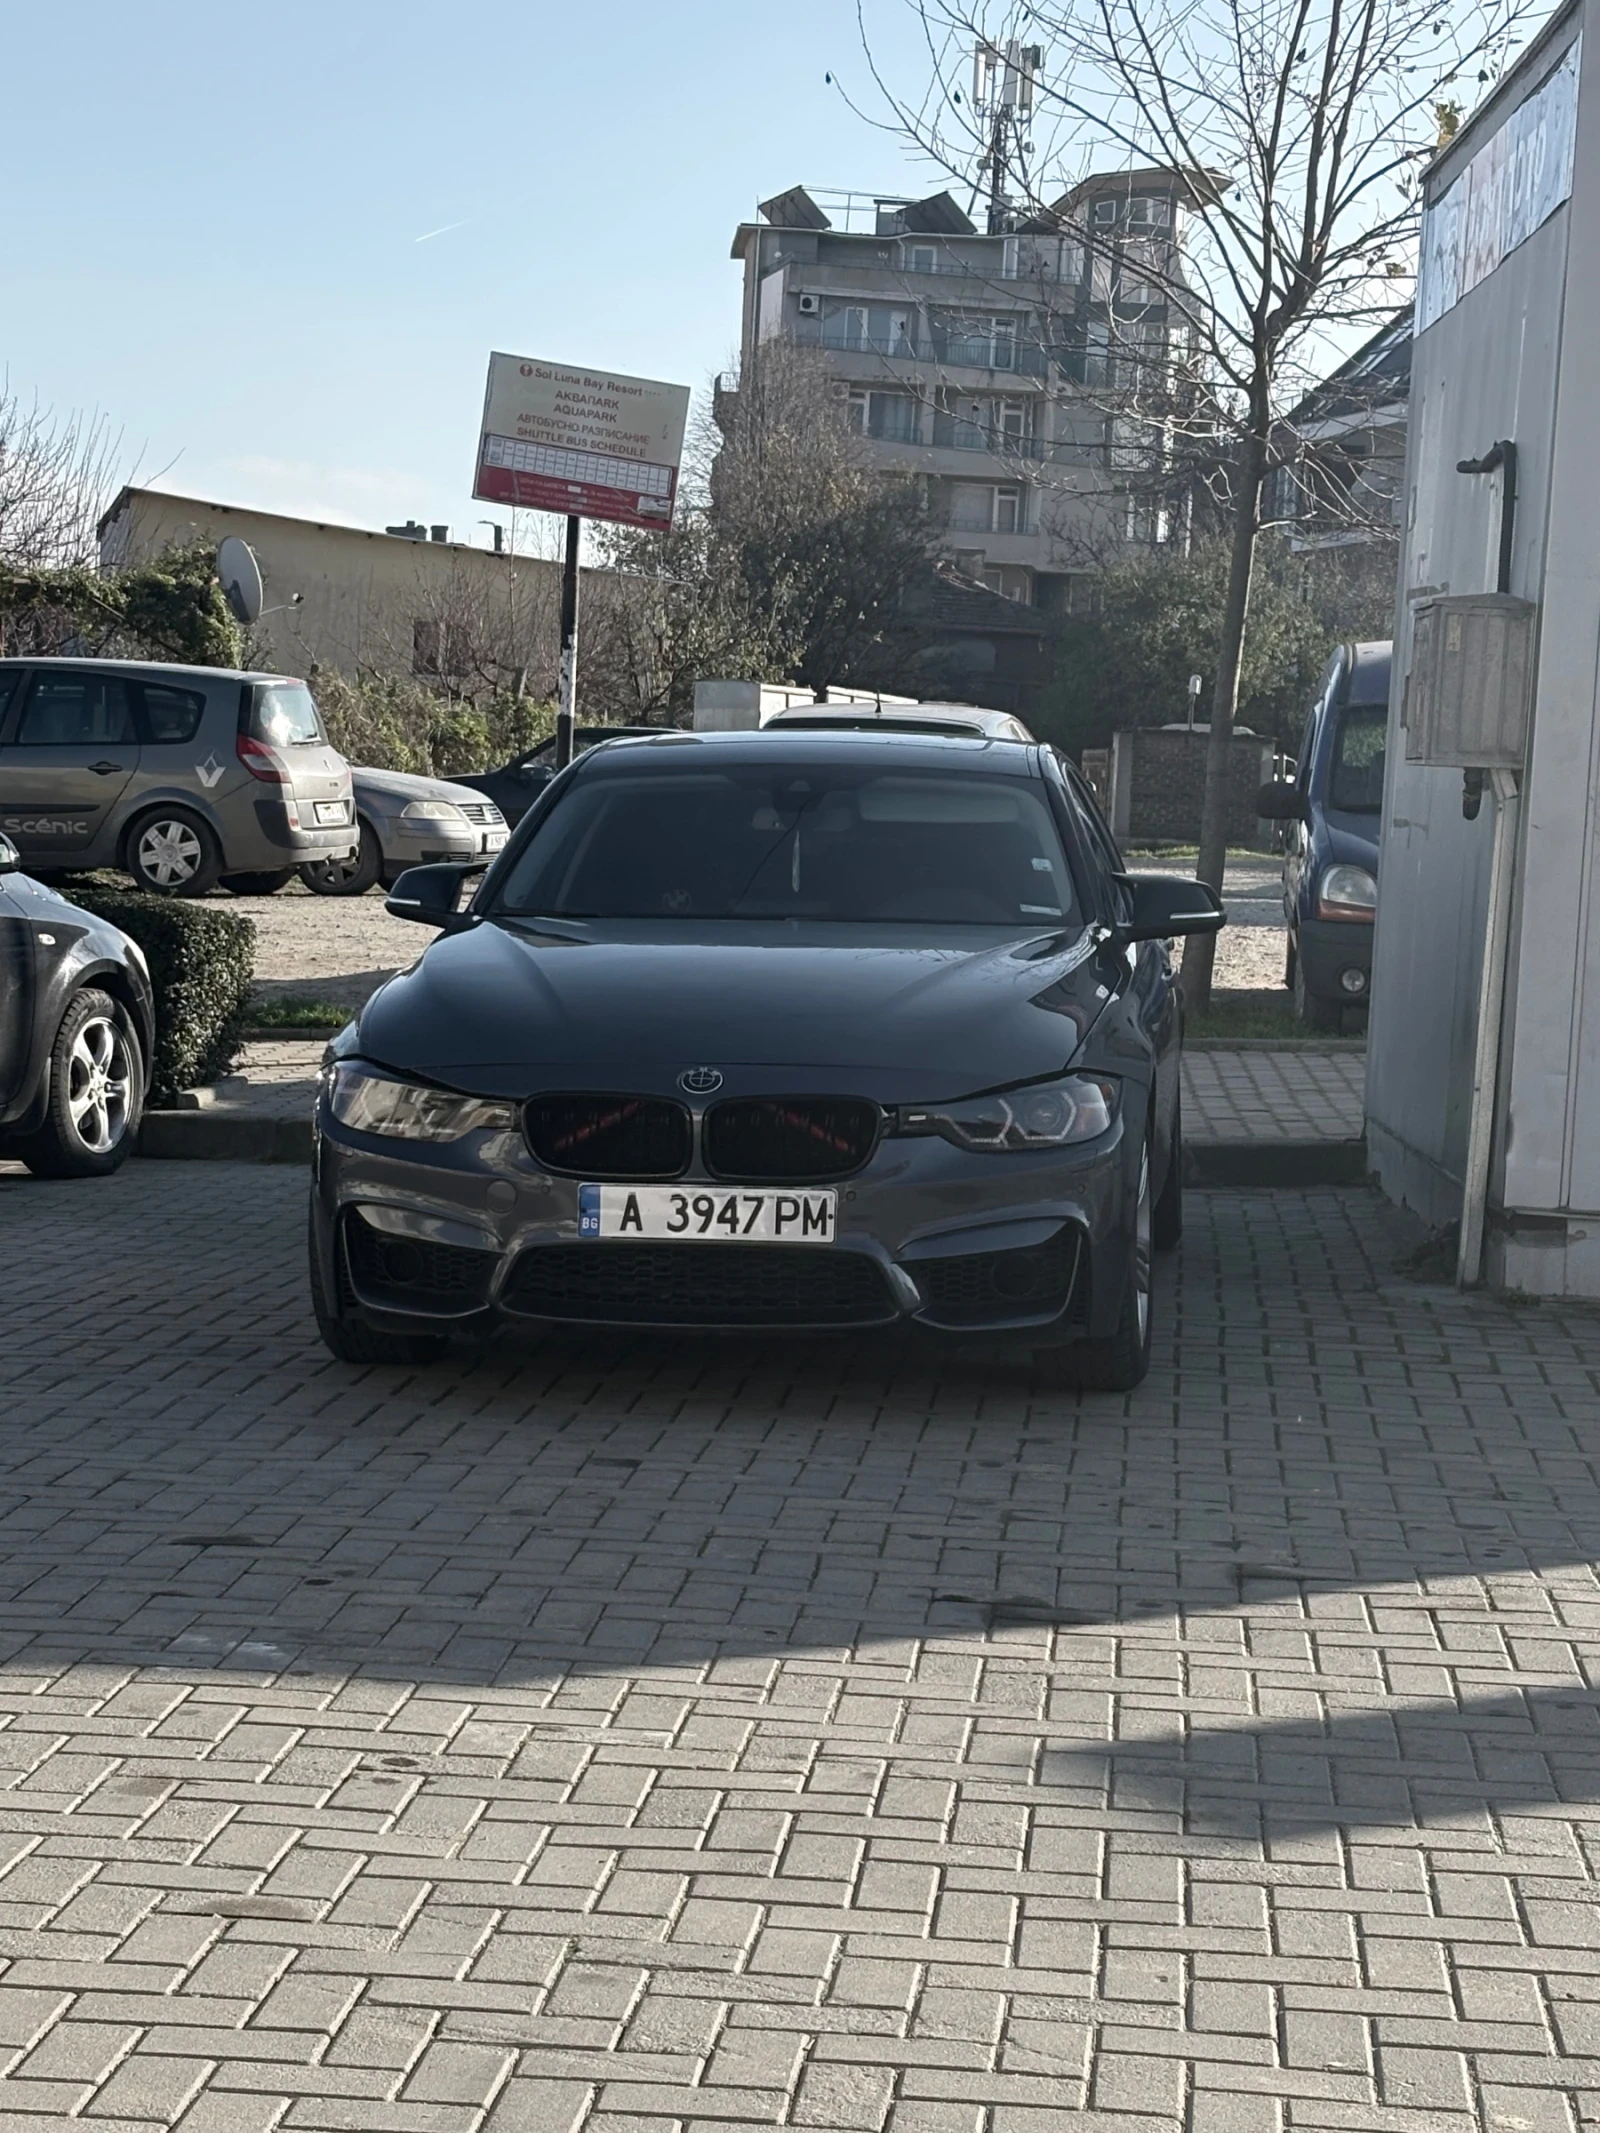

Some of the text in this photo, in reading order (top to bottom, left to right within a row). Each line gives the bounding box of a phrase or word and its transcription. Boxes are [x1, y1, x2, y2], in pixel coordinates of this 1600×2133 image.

[535, 367, 642, 396] Sol Luna Bay Resort
[553, 404, 617, 423] AQUAPARK
[517, 413, 650, 445] АВТОБУСНО РАЗПИСАНИЕ
[517, 427, 646, 458] SHUTTLE BUS SCHEDULE
[2, 818, 88, 834] Scénic
[581, 1217, 598, 1230] BG
[619, 1192, 827, 1236] A 3947 PM
